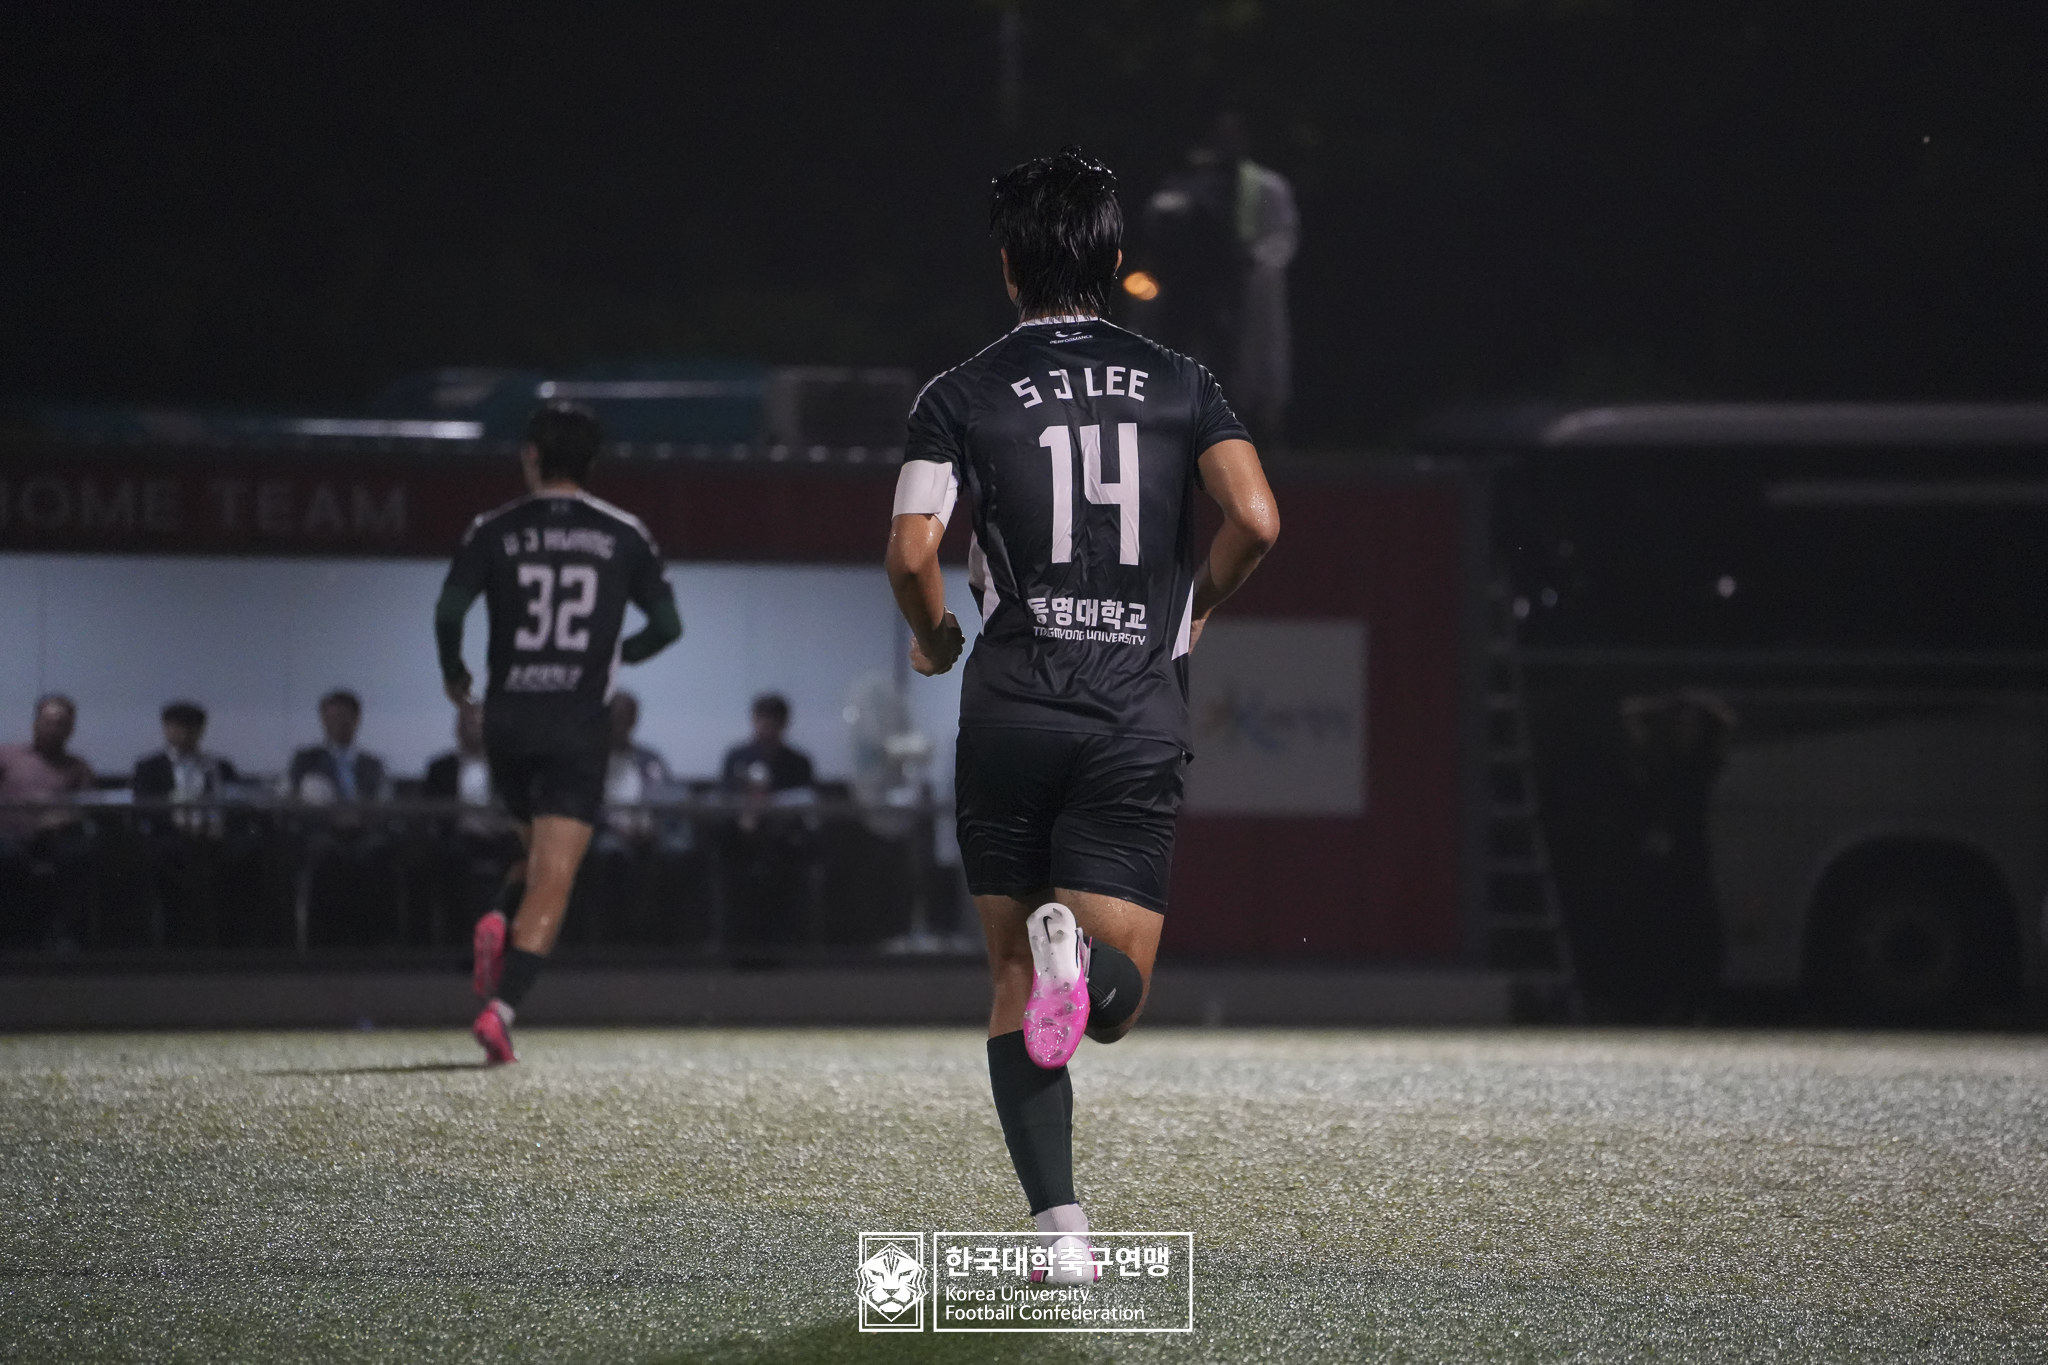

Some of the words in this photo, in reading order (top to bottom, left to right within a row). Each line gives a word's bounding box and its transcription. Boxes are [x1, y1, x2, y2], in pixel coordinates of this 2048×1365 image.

[1010, 376, 1044, 409] S
[1049, 368, 1074, 400] J
[1083, 365, 1149, 403] LEE
[0, 473, 182, 533] OME
[204, 476, 408, 537] TEAM
[1038, 422, 1140, 566] 14
[515, 564, 598, 650] 32
[1026, 596, 1147, 630] 동명대학교
[1086, 629, 1147, 646] UNIVERSITY
